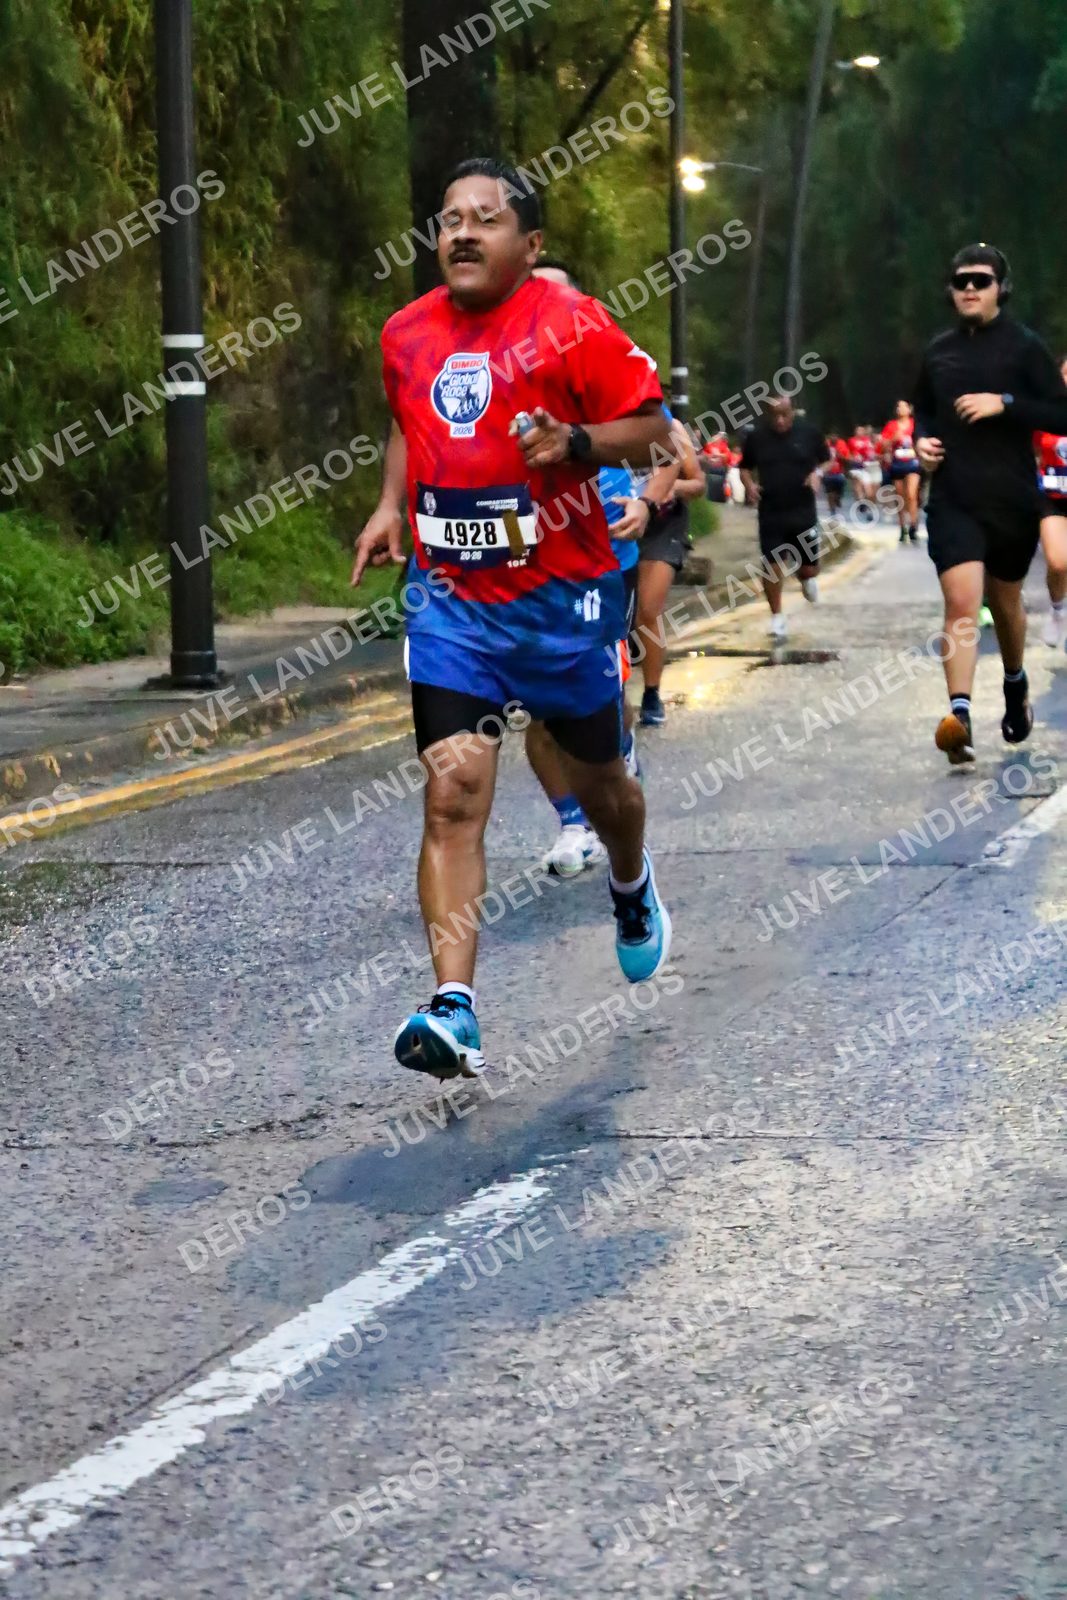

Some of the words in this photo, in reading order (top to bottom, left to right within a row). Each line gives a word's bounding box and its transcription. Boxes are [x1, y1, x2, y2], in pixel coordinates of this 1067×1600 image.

[451, 359, 483, 370] BIMBO
[449, 371, 480, 387] Global
[441, 385, 468, 398] Race
[444, 521, 498, 547] 4928
